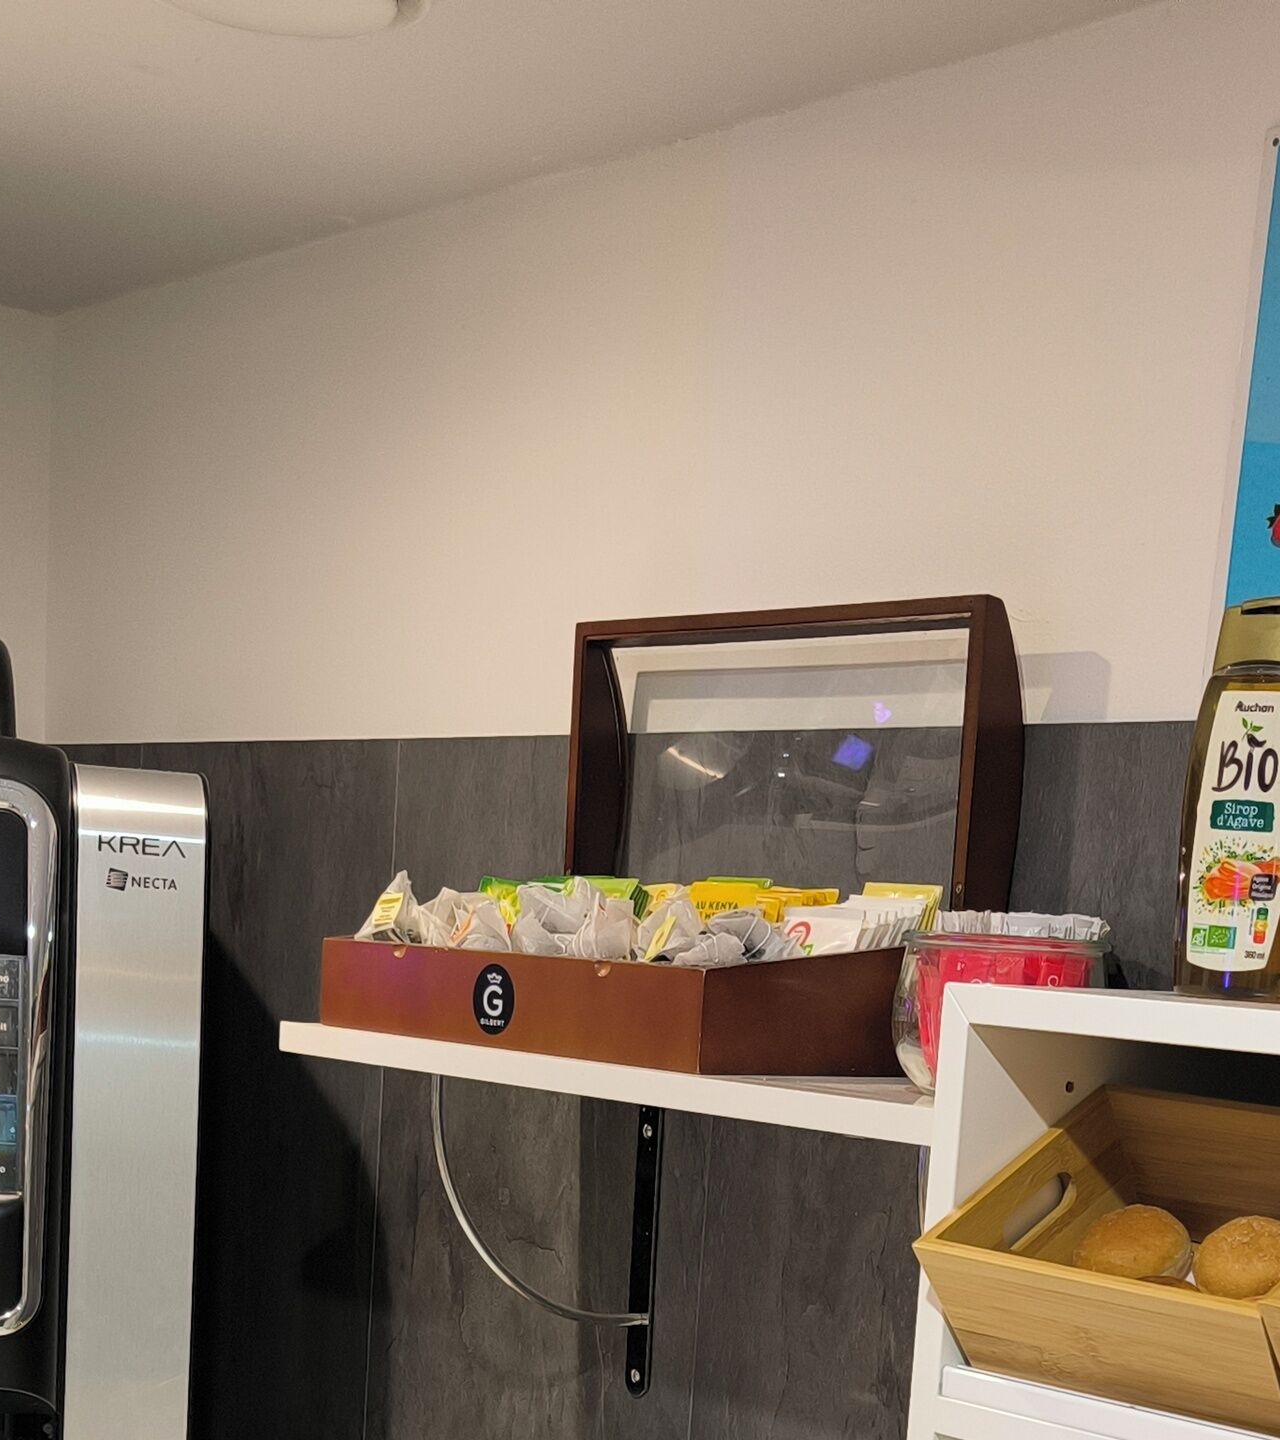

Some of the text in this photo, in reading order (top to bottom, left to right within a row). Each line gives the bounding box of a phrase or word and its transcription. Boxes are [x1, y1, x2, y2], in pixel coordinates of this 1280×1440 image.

[1235, 700, 1275, 713] Auchan
[1224, 802, 1258, 817] Sirop
[1216, 814, 1265, 829] d'Agave
[131, 876, 178, 891] NECTA
[483, 985, 503, 1017] G
